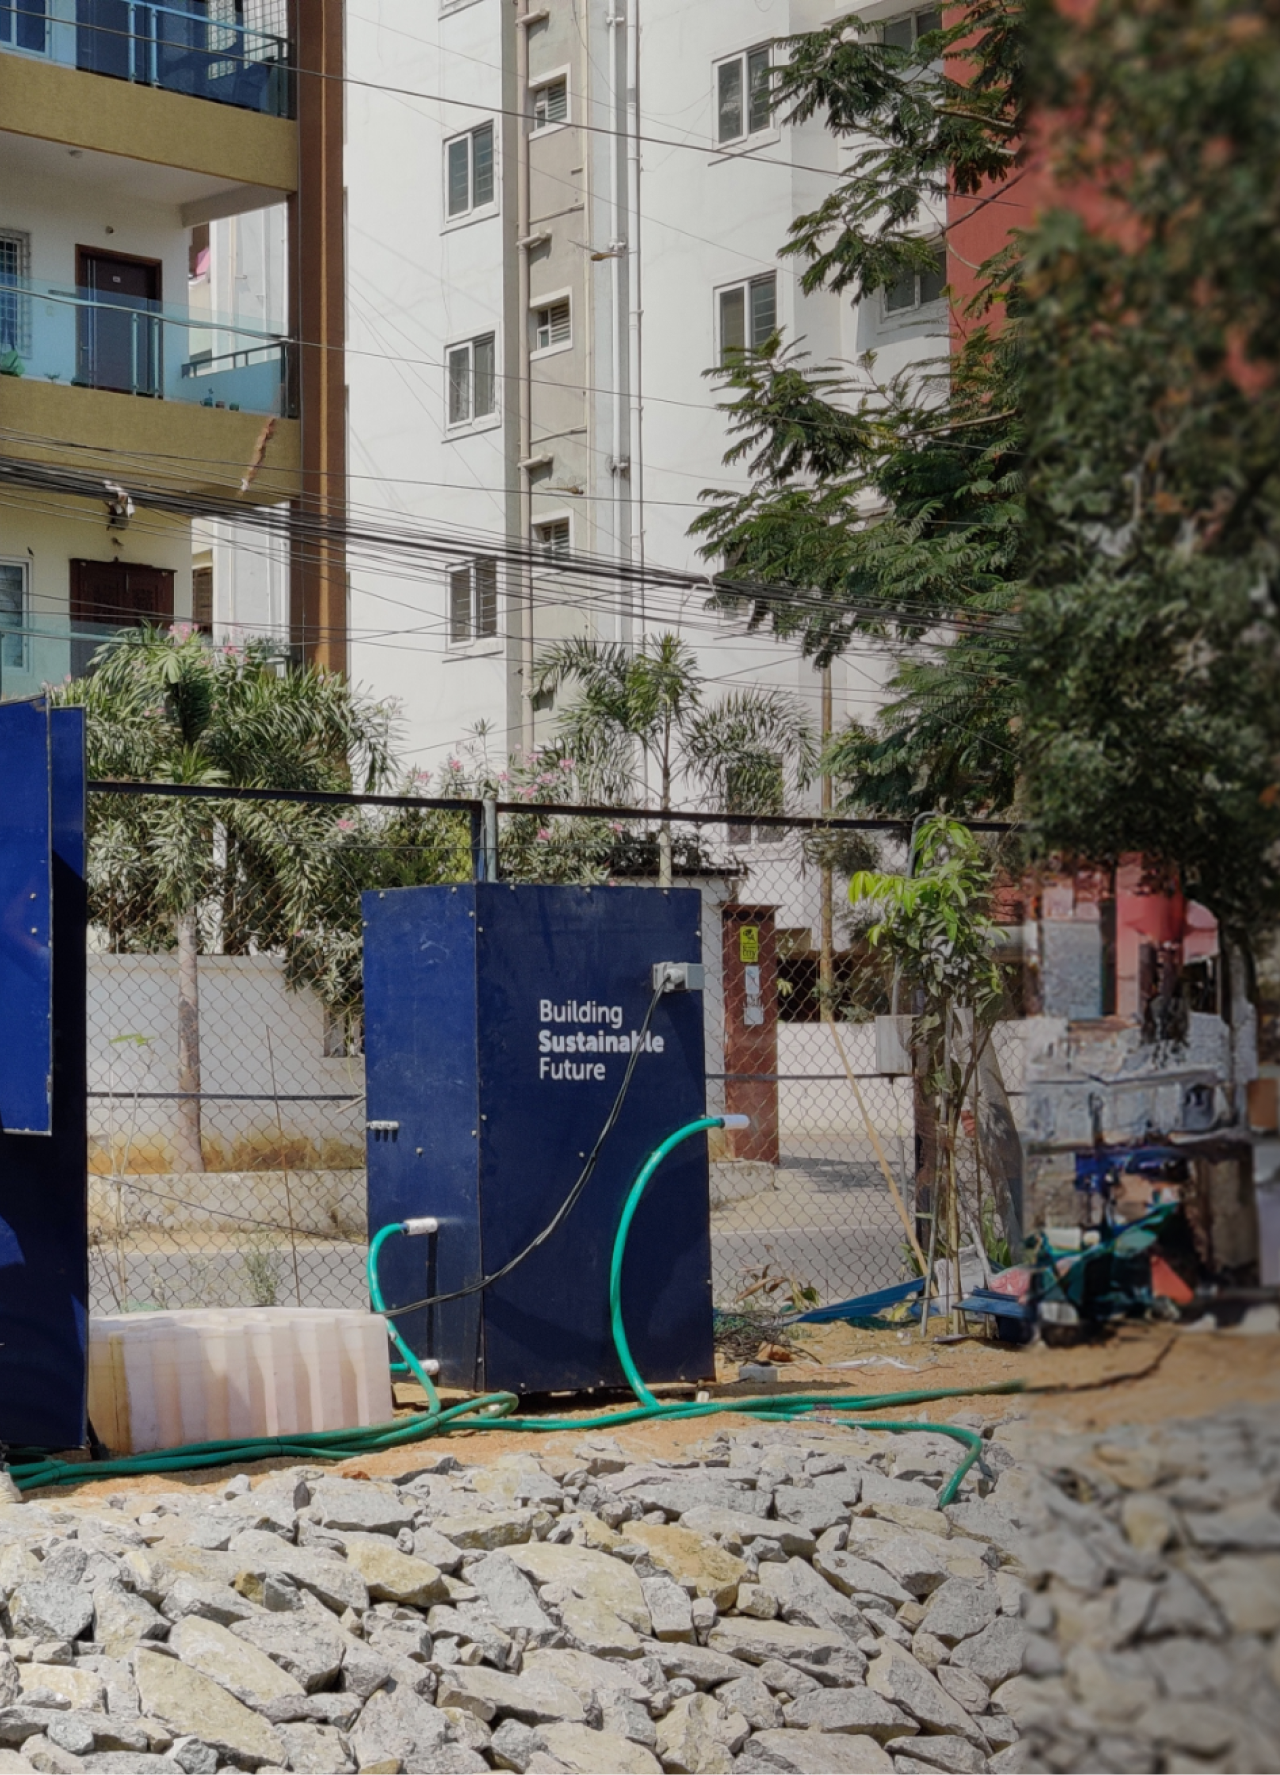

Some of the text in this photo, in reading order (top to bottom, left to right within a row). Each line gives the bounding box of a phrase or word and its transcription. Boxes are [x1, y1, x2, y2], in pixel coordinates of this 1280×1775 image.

[540, 999, 623, 1029] Building
[538, 1029, 665, 1053] Sustainable
[540, 1057, 606, 1081] Future
